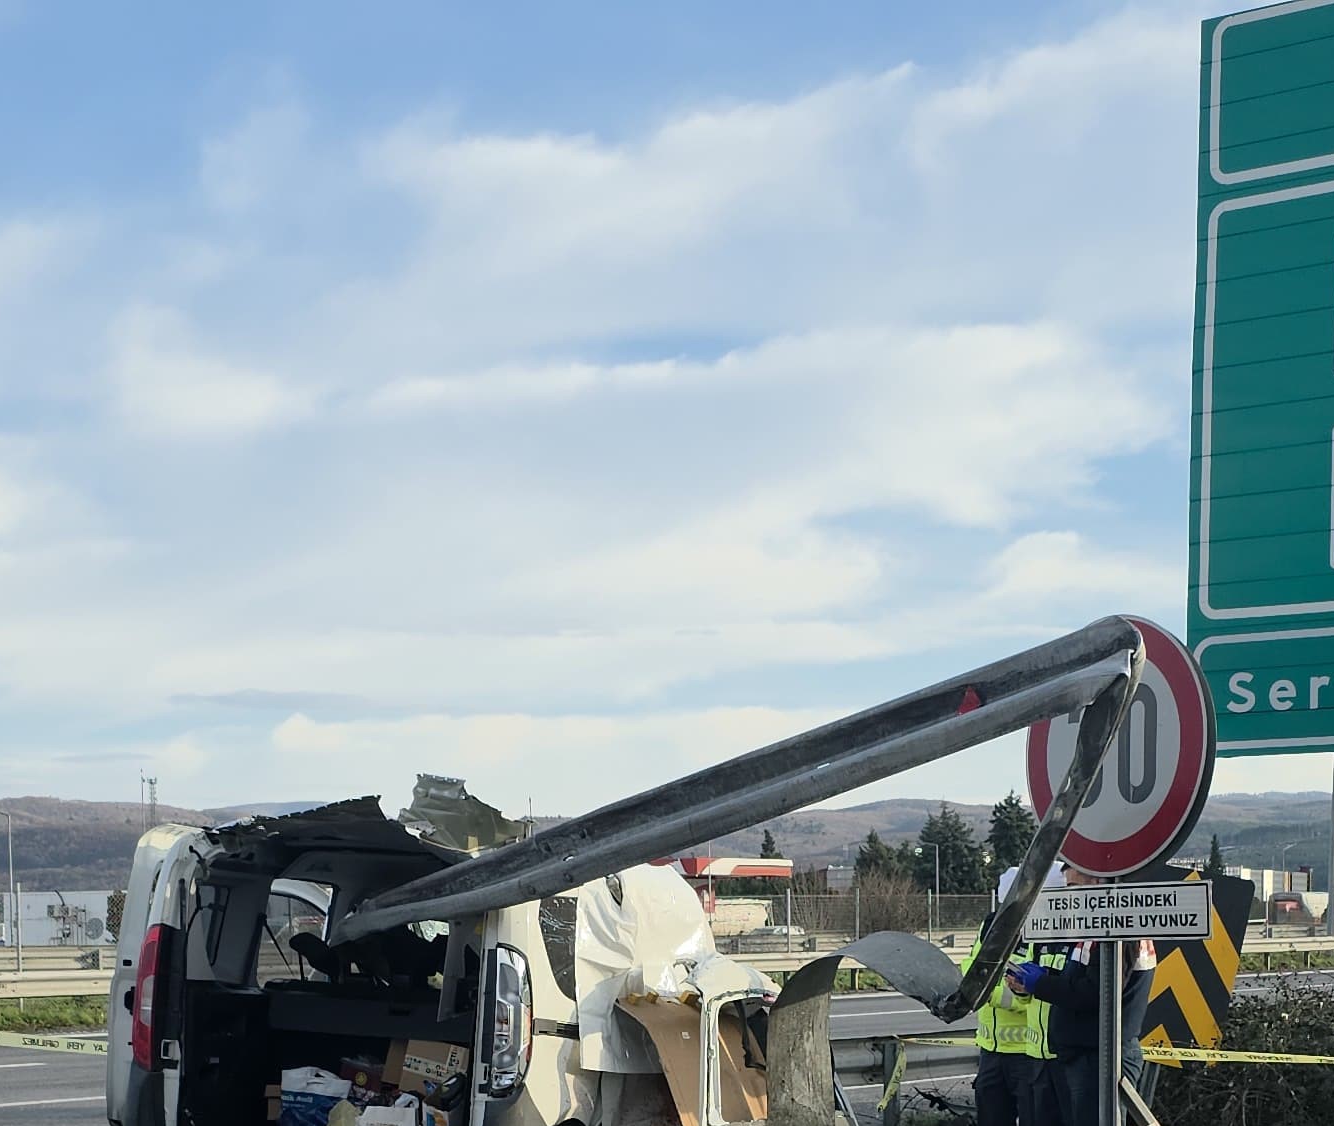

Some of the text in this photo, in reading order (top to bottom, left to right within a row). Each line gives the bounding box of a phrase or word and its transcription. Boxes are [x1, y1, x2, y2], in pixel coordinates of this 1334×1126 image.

[1067, 683, 1158, 809] 0
[1031, 918, 1050, 931] HIZ
[1139, 913, 1198, 928] UYUNUZ
